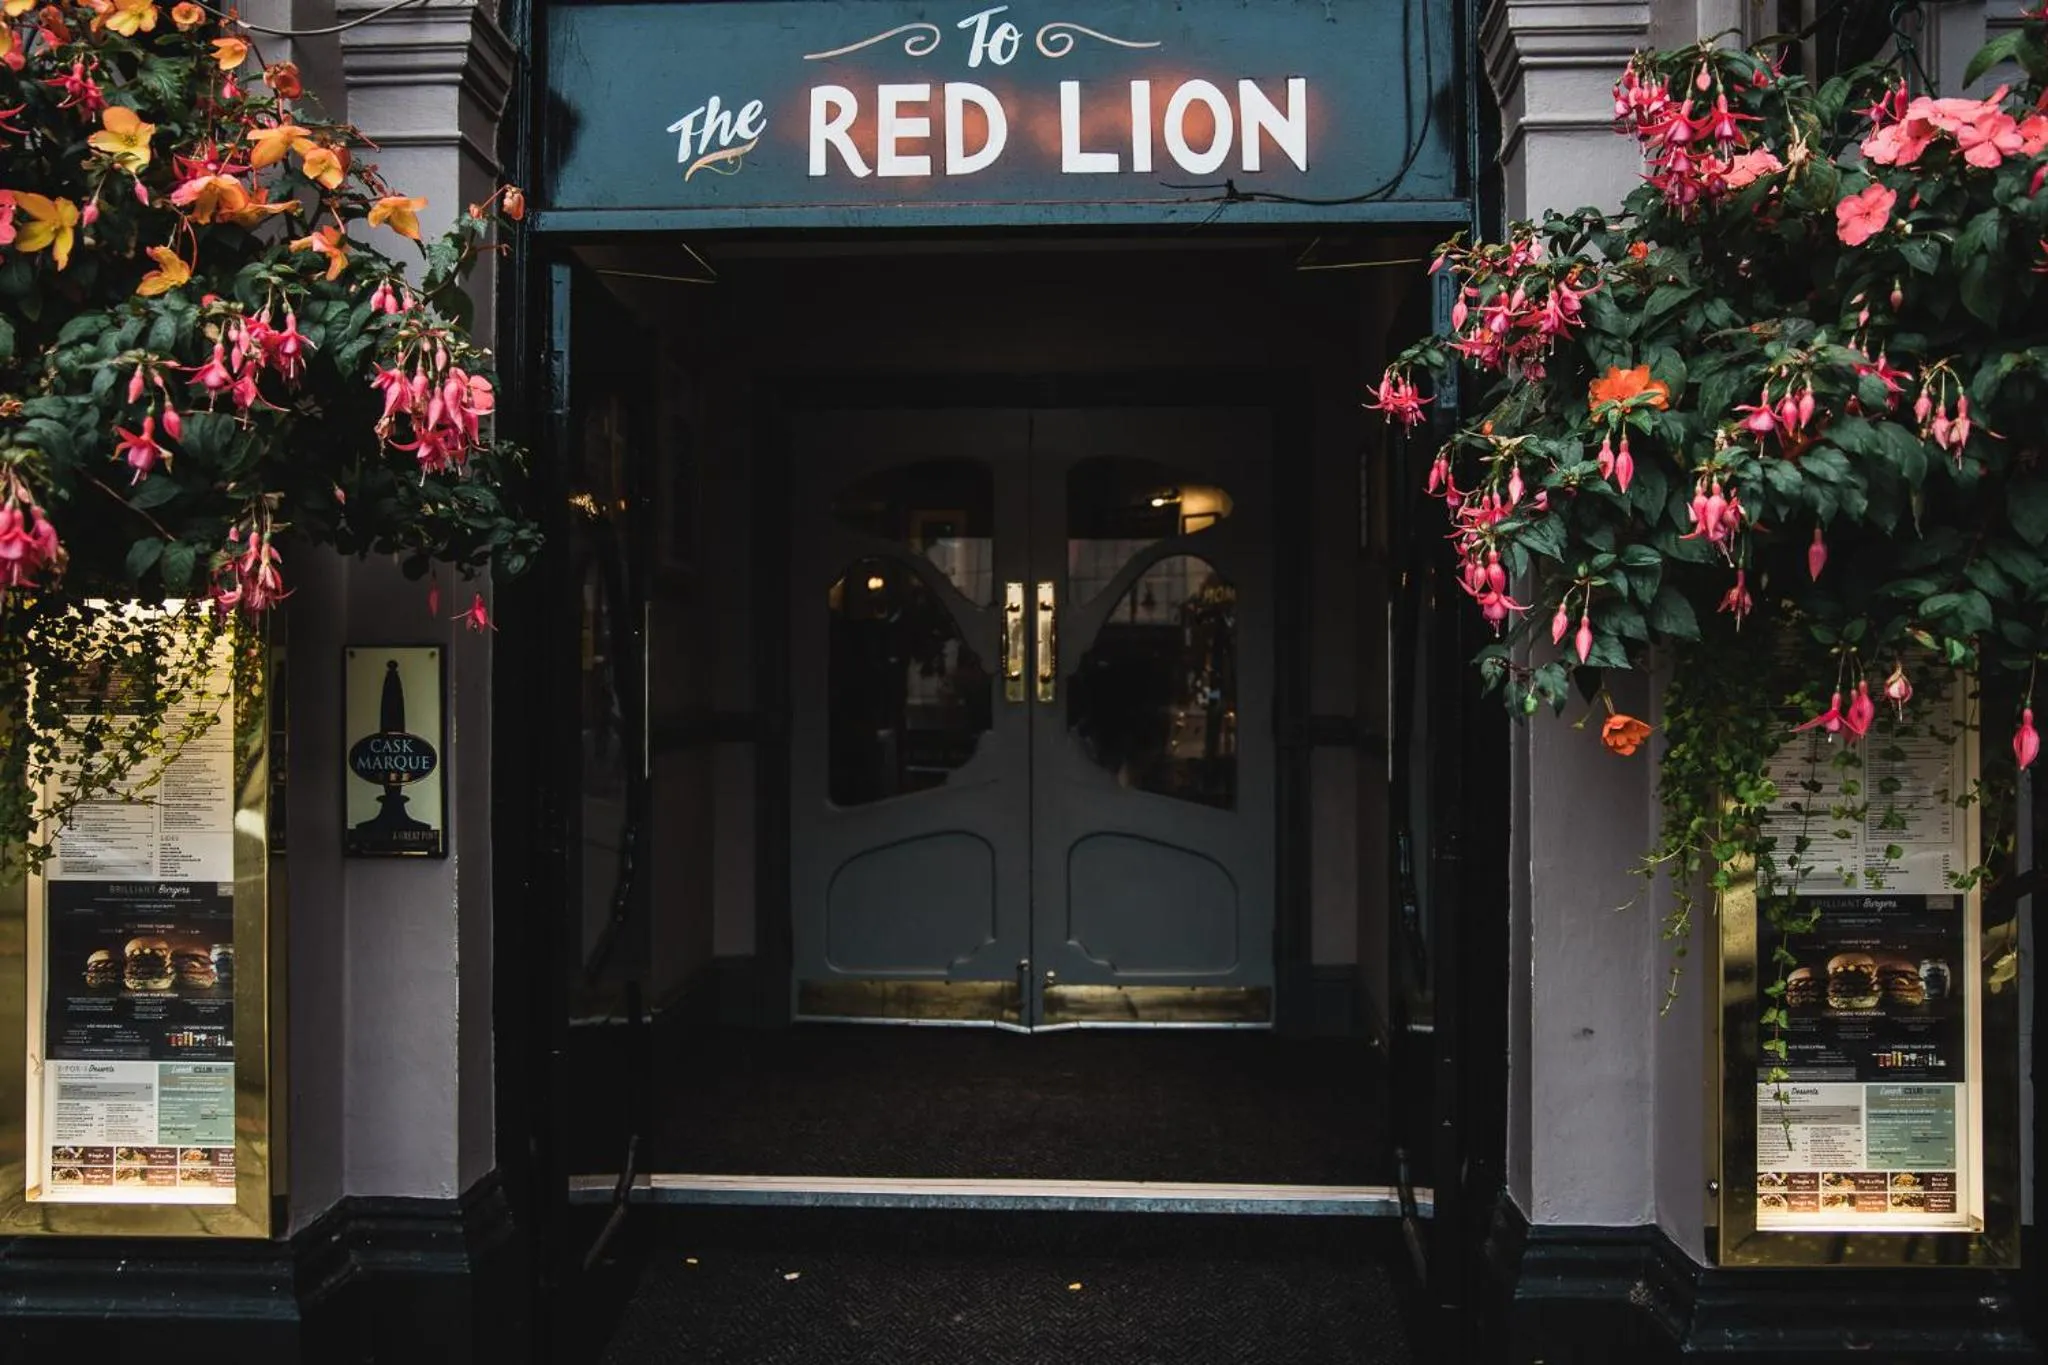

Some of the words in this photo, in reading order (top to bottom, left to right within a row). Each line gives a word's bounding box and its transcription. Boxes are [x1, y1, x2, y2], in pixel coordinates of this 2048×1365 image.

[956, 5, 1023, 67] To
[667, 95, 767, 163] The
[809, 81, 1008, 177] RED
[1060, 77, 1308, 175] LION
[356, 755, 430, 772] MARQUE
[370, 739, 414, 753] CASK
